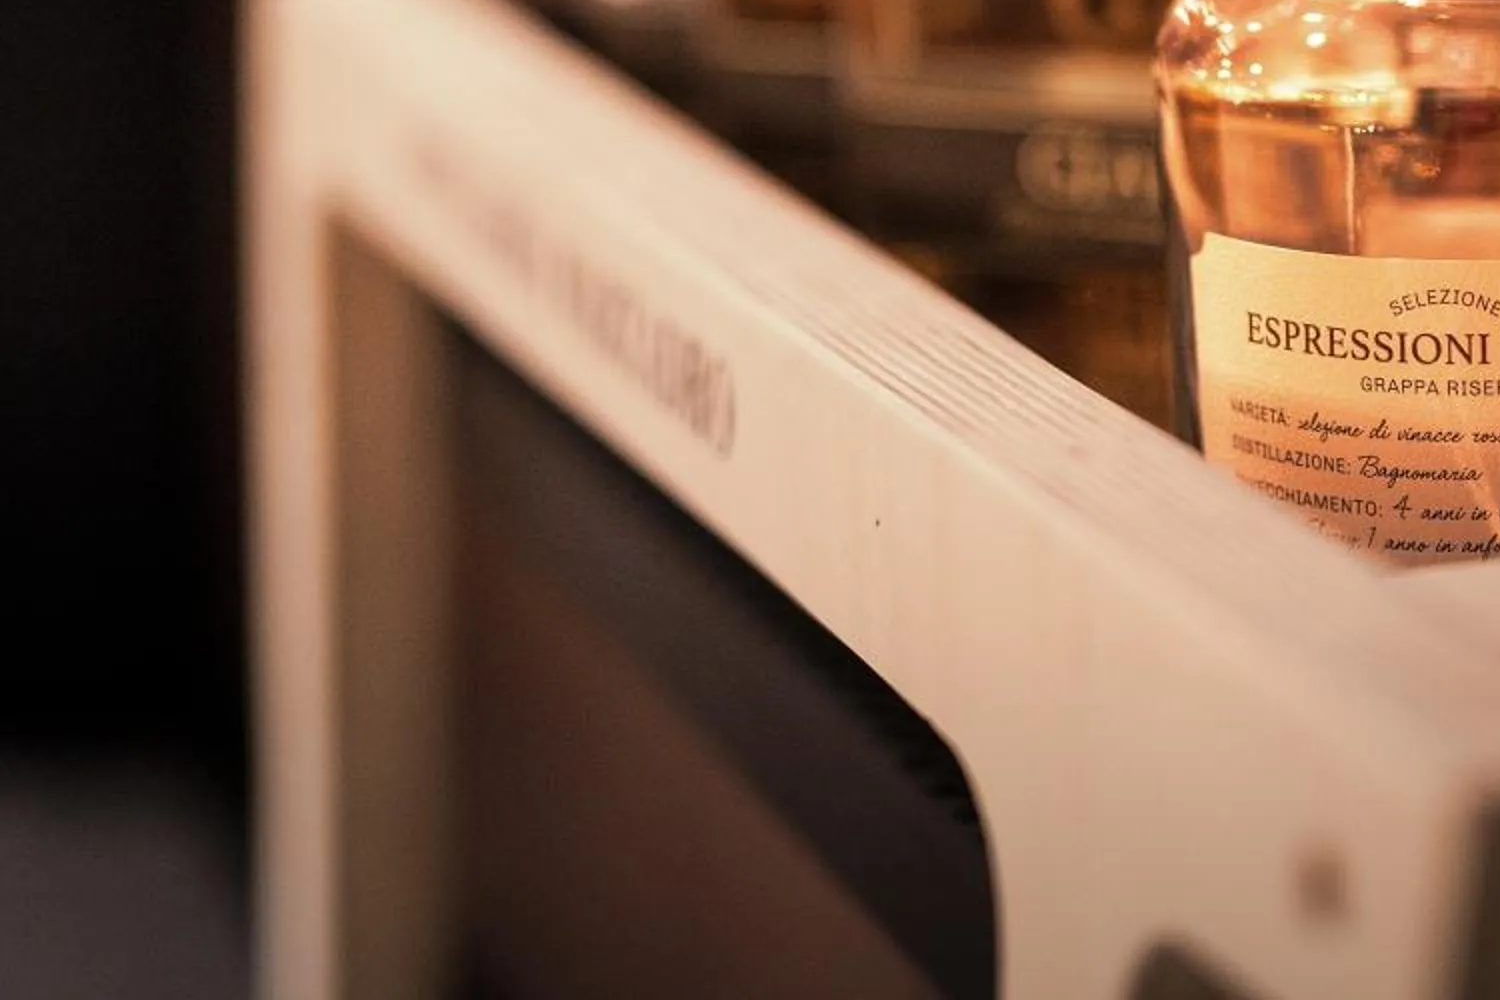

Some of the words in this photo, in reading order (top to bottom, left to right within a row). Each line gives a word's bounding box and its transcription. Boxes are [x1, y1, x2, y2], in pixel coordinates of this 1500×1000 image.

[1247, 311, 1491, 366] ESPRESSIONI
[1360, 376, 1440, 396] GRAPPA
[1297, 411, 1364, 443] selezione
[1368, 419, 1392, 440] di
[1397, 426, 1464, 443] vinacce
[1232, 433, 1351, 475] DISTILLAZIONE:
[1357, 455, 1484, 489] Bagnomaria
[1392, 495, 1412, 520] 4
[1420, 506, 1466, 521] anni
[1470, 506, 1492, 521] in
[1384, 538, 1431, 552] anno
[1435, 537, 1457, 553] in
